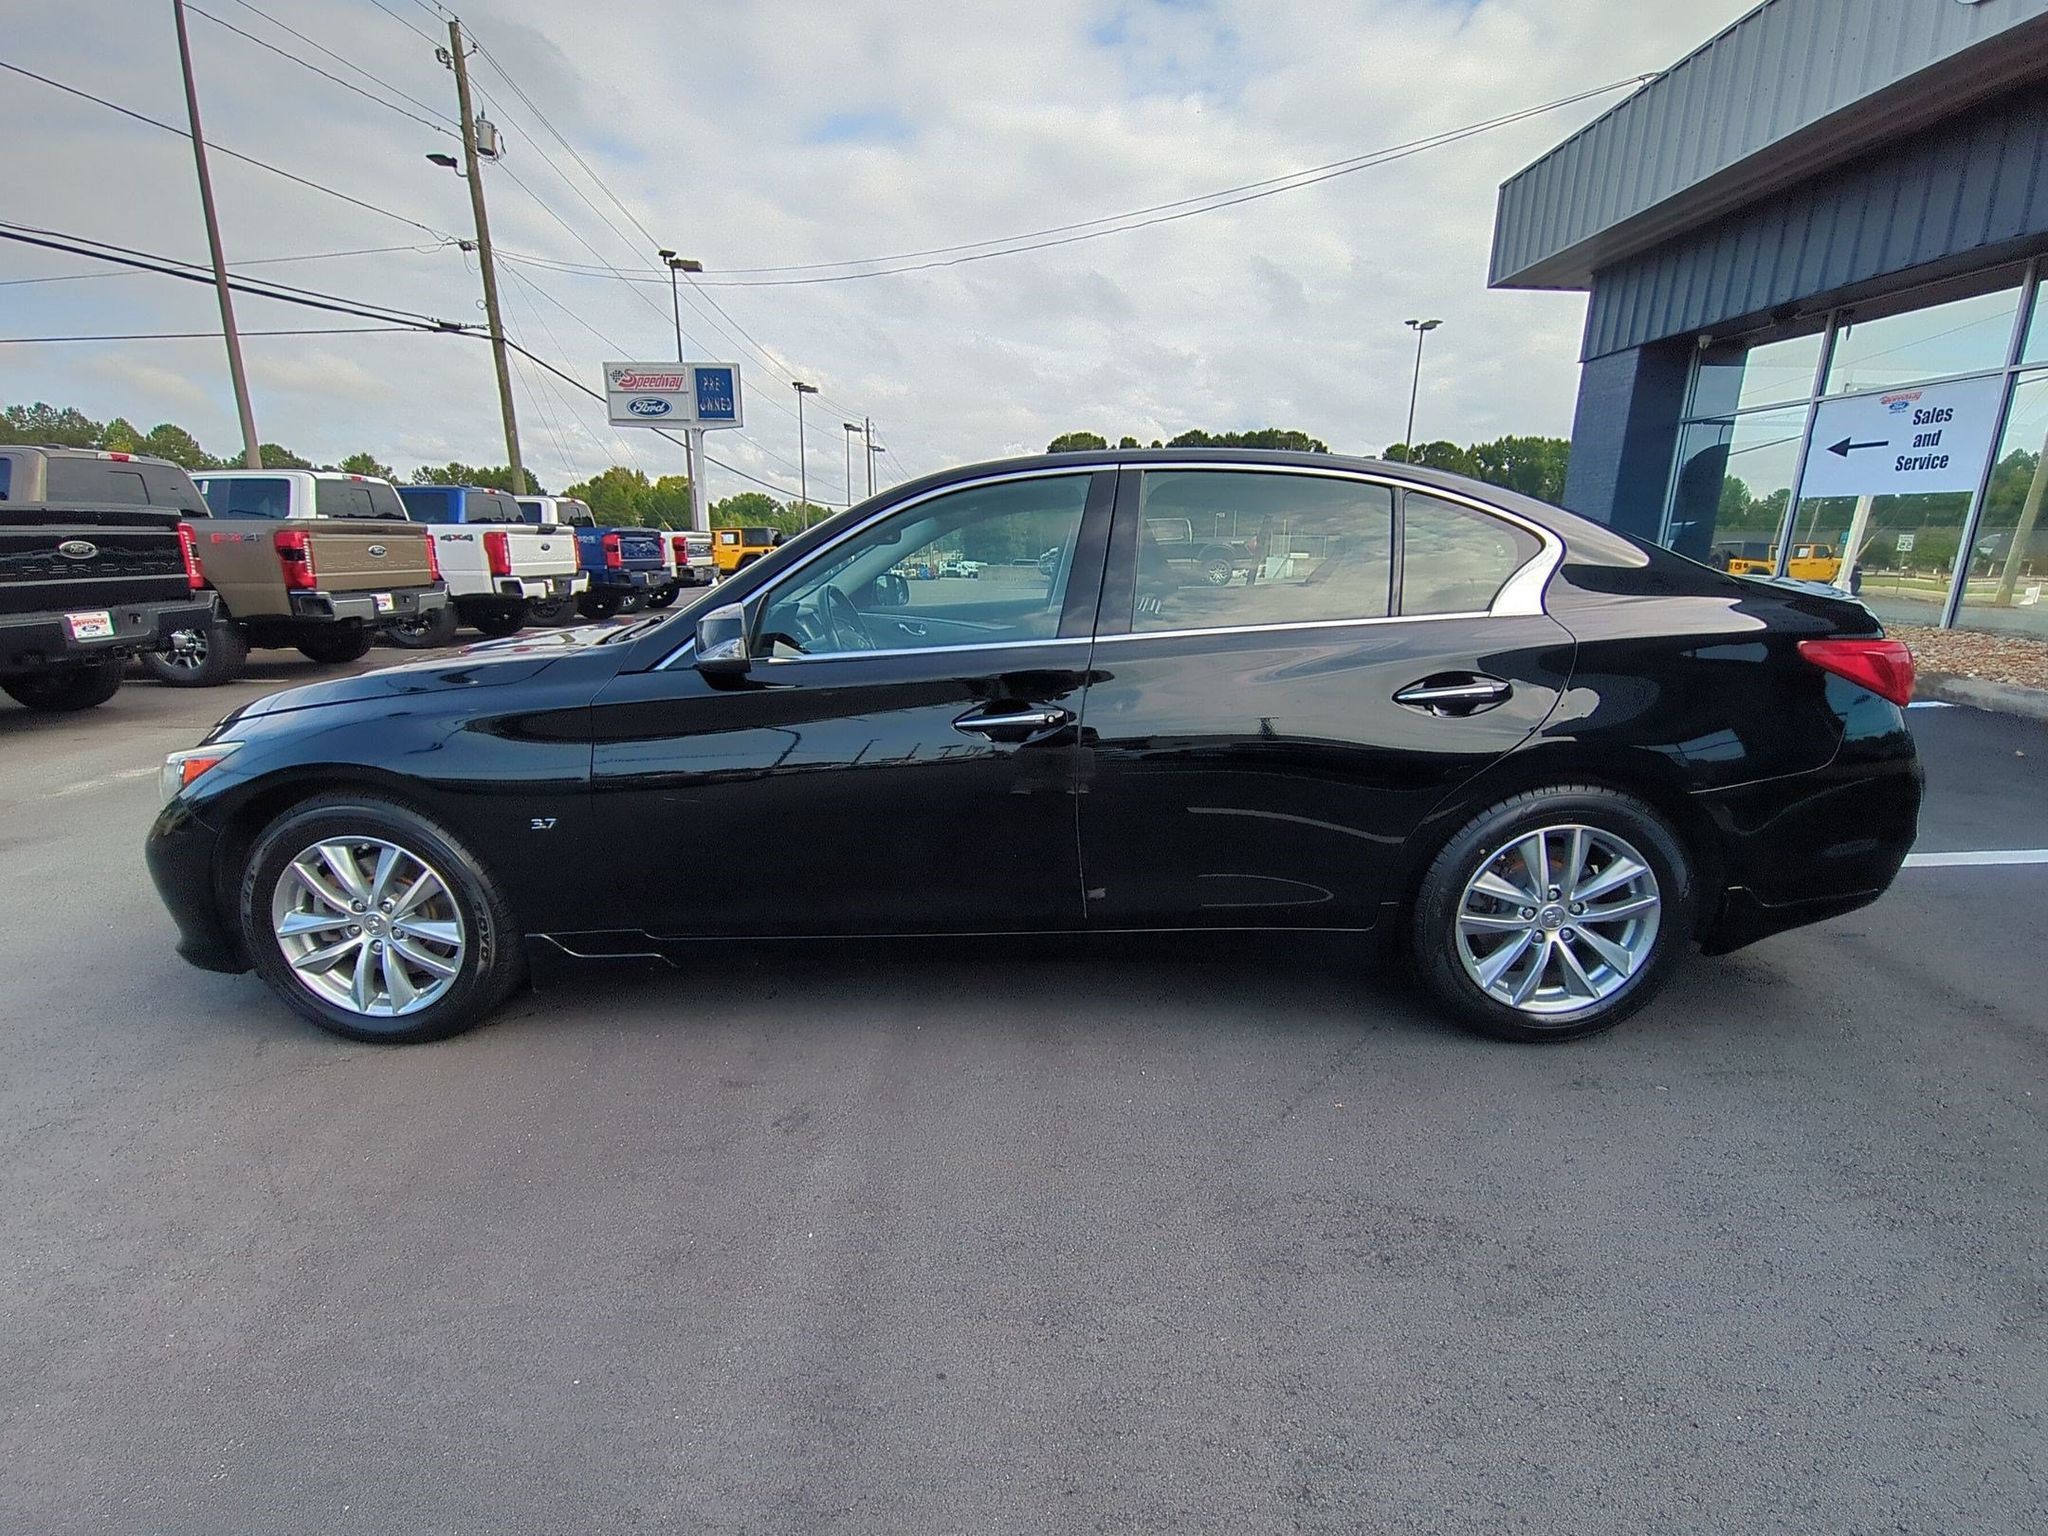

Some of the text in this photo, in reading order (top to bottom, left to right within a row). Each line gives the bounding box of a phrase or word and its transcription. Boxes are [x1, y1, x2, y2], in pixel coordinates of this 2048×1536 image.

[700, 397, 732, 412] OWNED
[1912, 407, 1954, 426] Sales
[1912, 429, 1943, 448] and
[1895, 453, 1949, 472] Service
